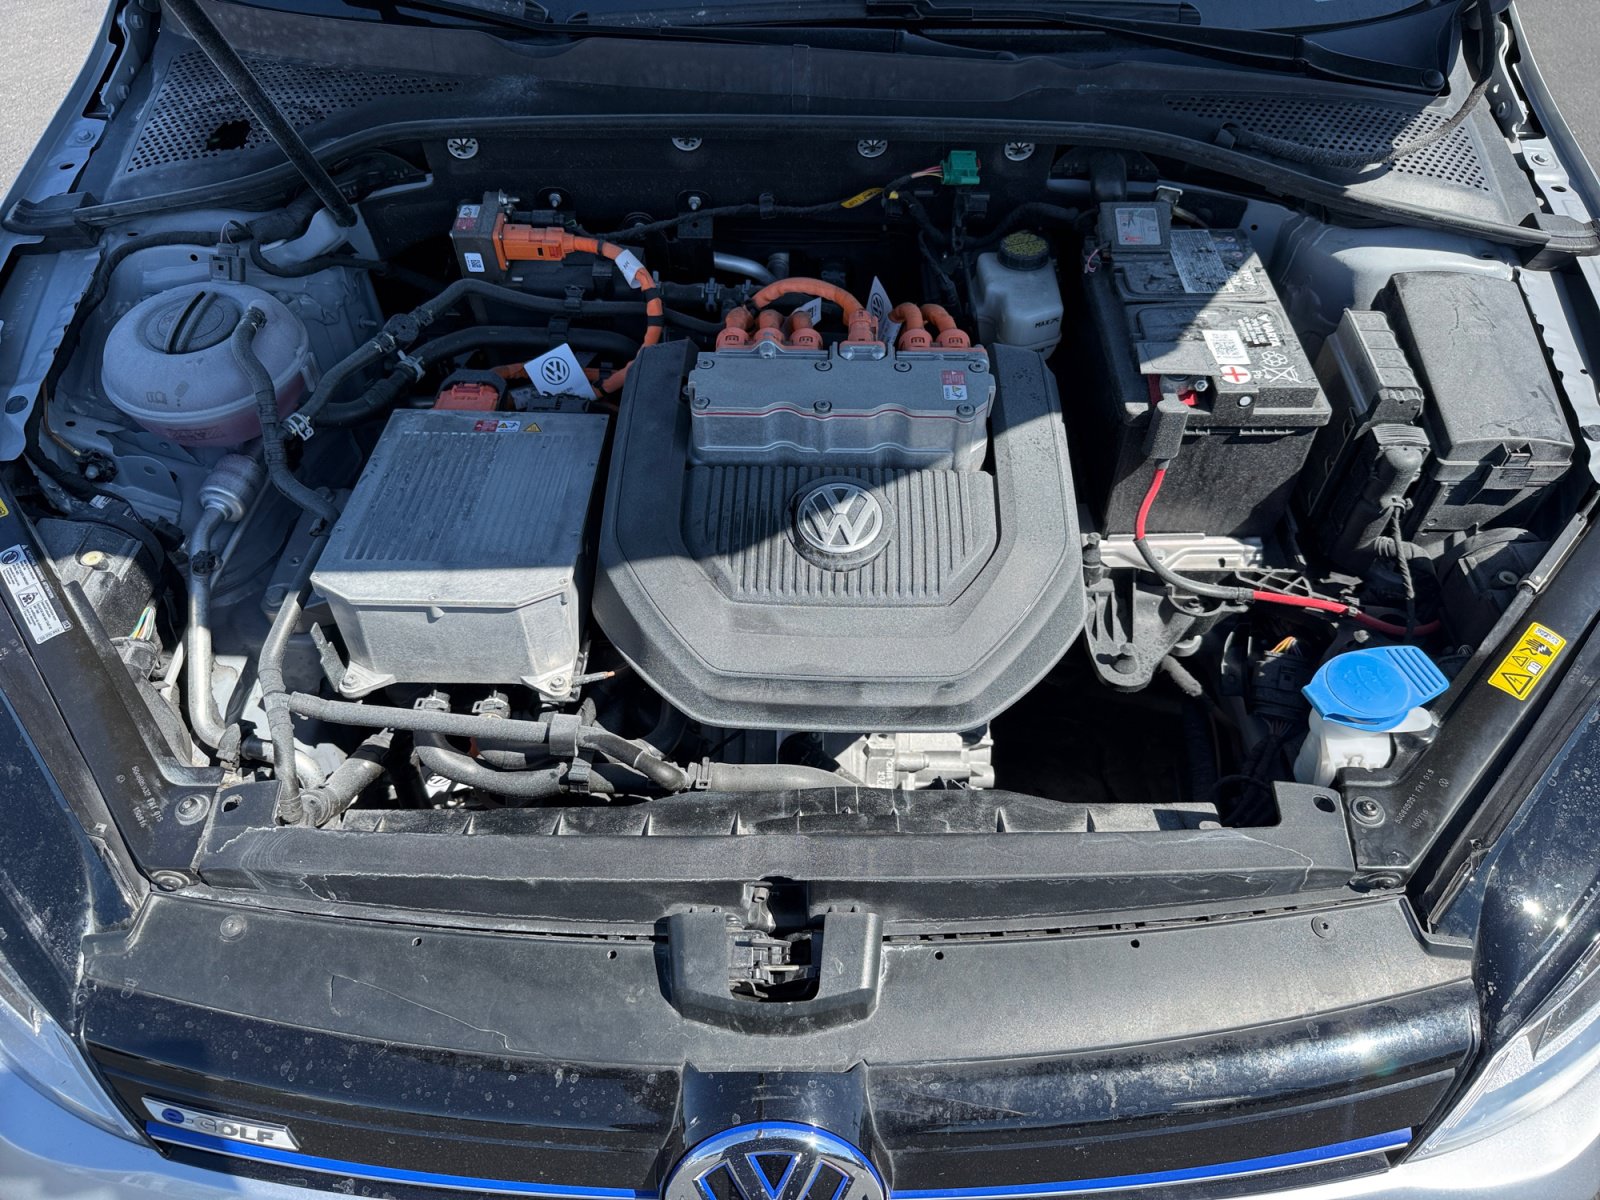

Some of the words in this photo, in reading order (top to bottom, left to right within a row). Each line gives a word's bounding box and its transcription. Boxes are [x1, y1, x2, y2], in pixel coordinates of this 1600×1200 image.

[1035, 320, 1049, 328] MAX
[1262, 322, 1281, 347] VARTA
[797, 482, 883, 554] VW
[161, 1107, 275, 1143] e-GOLF
